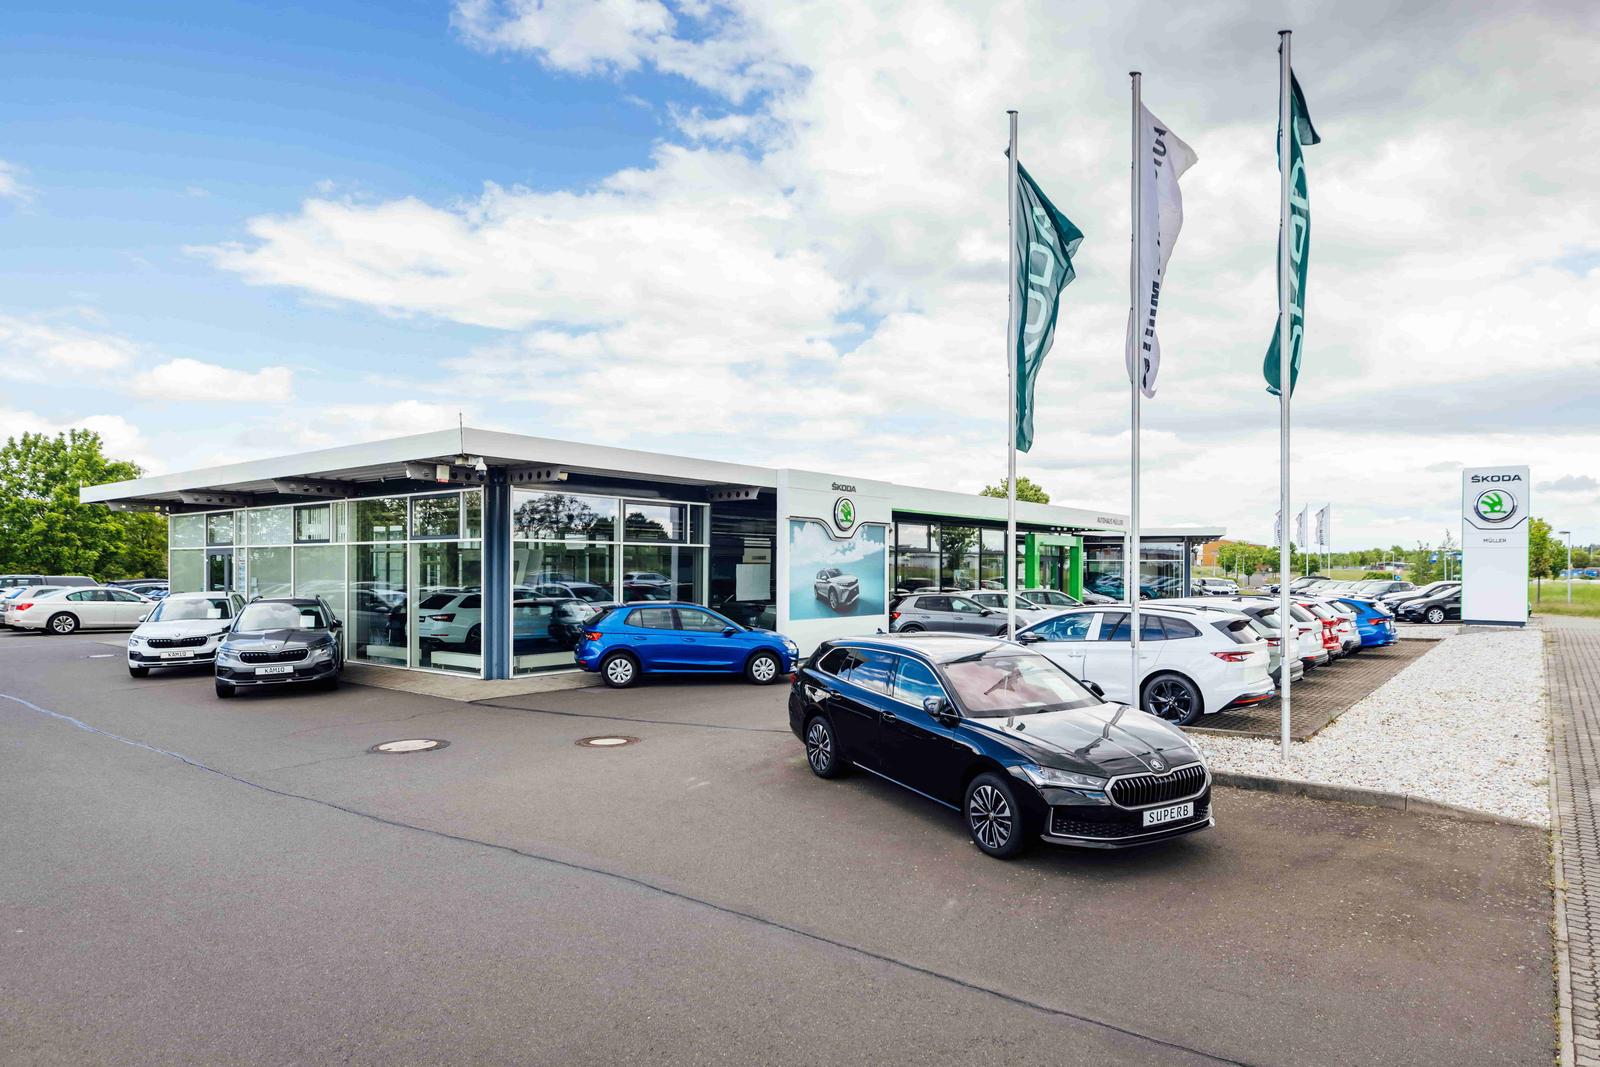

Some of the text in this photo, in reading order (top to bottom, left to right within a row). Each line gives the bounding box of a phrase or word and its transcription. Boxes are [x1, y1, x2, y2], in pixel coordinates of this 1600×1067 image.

[1471, 474, 1522, 483] ŠKODA
[831, 482, 857, 492] ŠKODA
[1149, 805, 1189, 823] SUPERB
